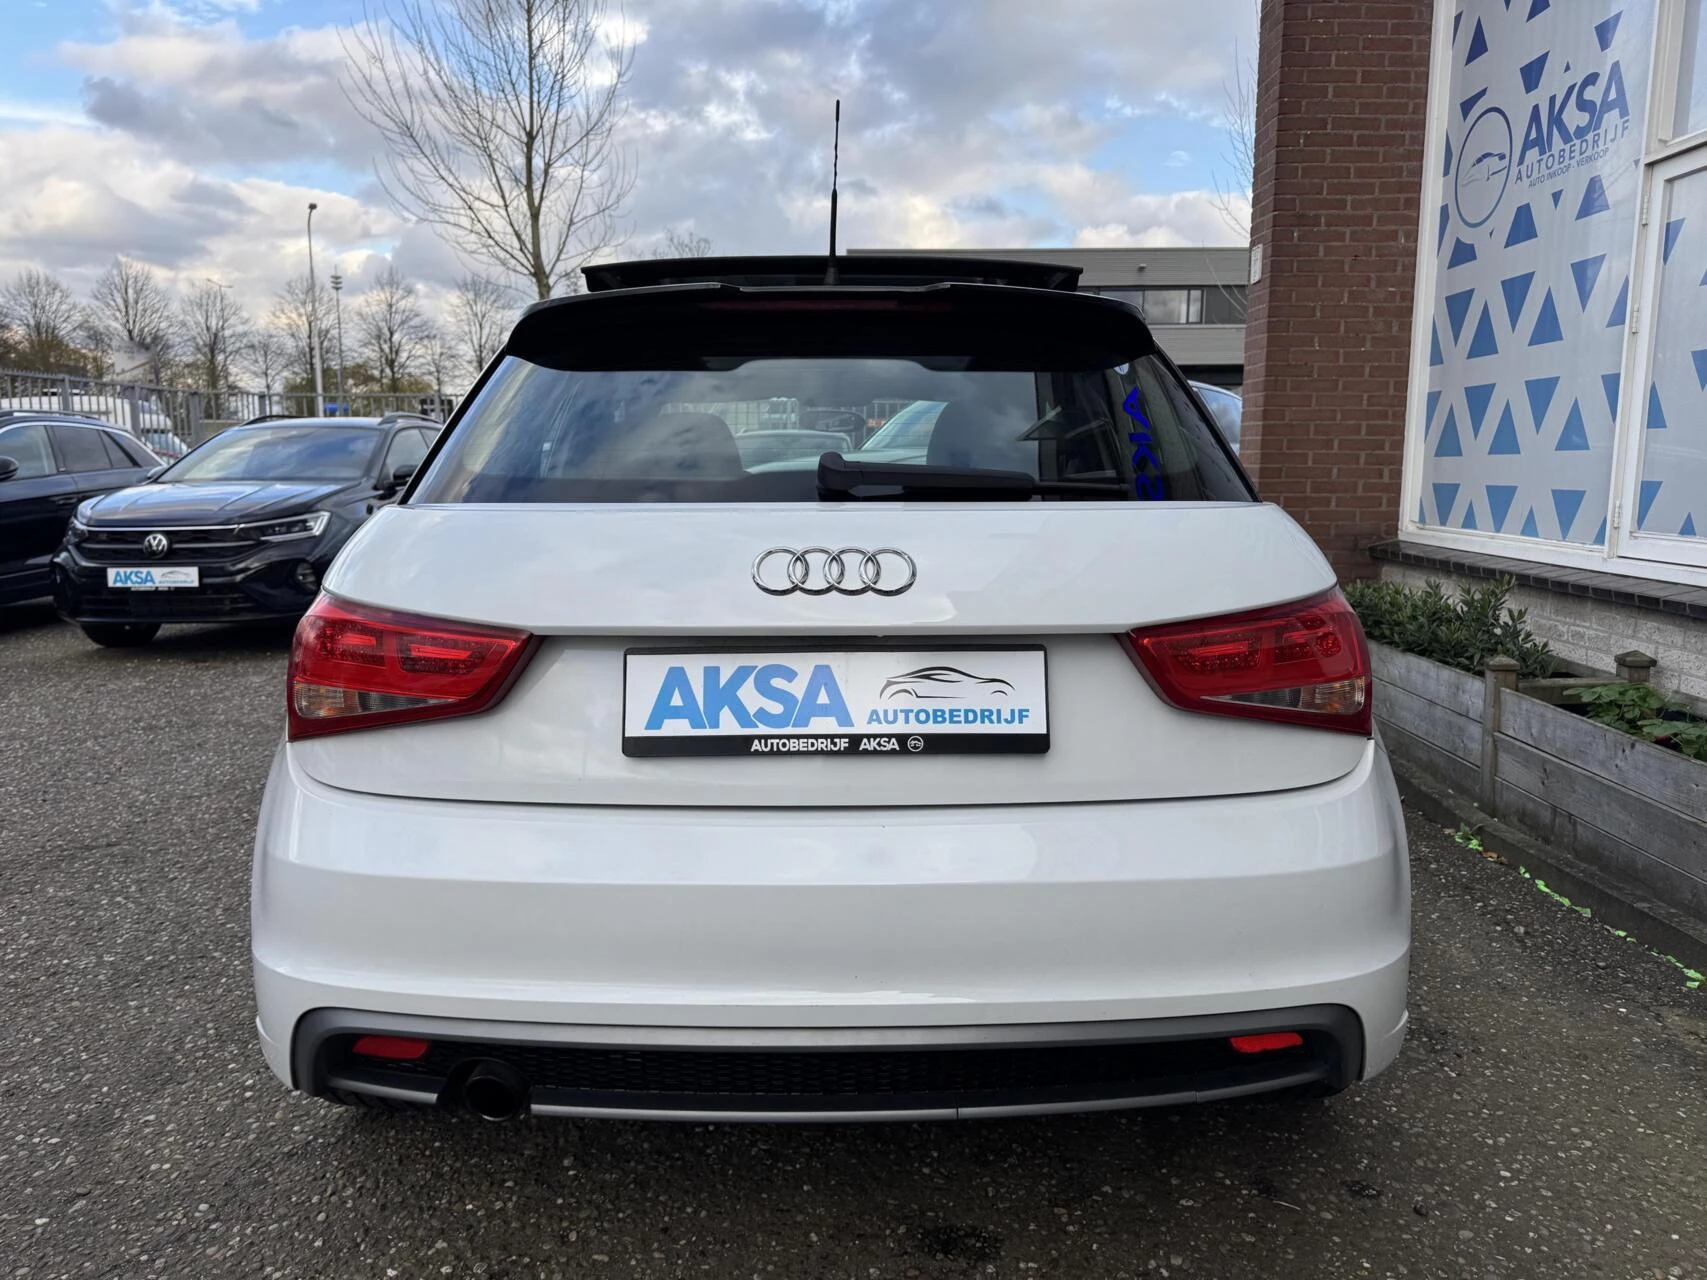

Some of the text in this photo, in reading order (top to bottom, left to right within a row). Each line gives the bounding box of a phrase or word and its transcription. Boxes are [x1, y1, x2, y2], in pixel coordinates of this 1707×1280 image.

[1516, 60, 1630, 167] AKSA
[1514, 118, 1630, 185] AUTOBEDRIJF
[1528, 174, 1546, 188] AUTO
[1576, 147, 1610, 168] VERKOOP
[113, 570, 156, 585] AKSA
[644, 664, 855, 730] AKSA
[866, 708, 1030, 725] AUTOBEDRIJF
[750, 738, 900, 752] AUTOBEDRIJF AKSA
